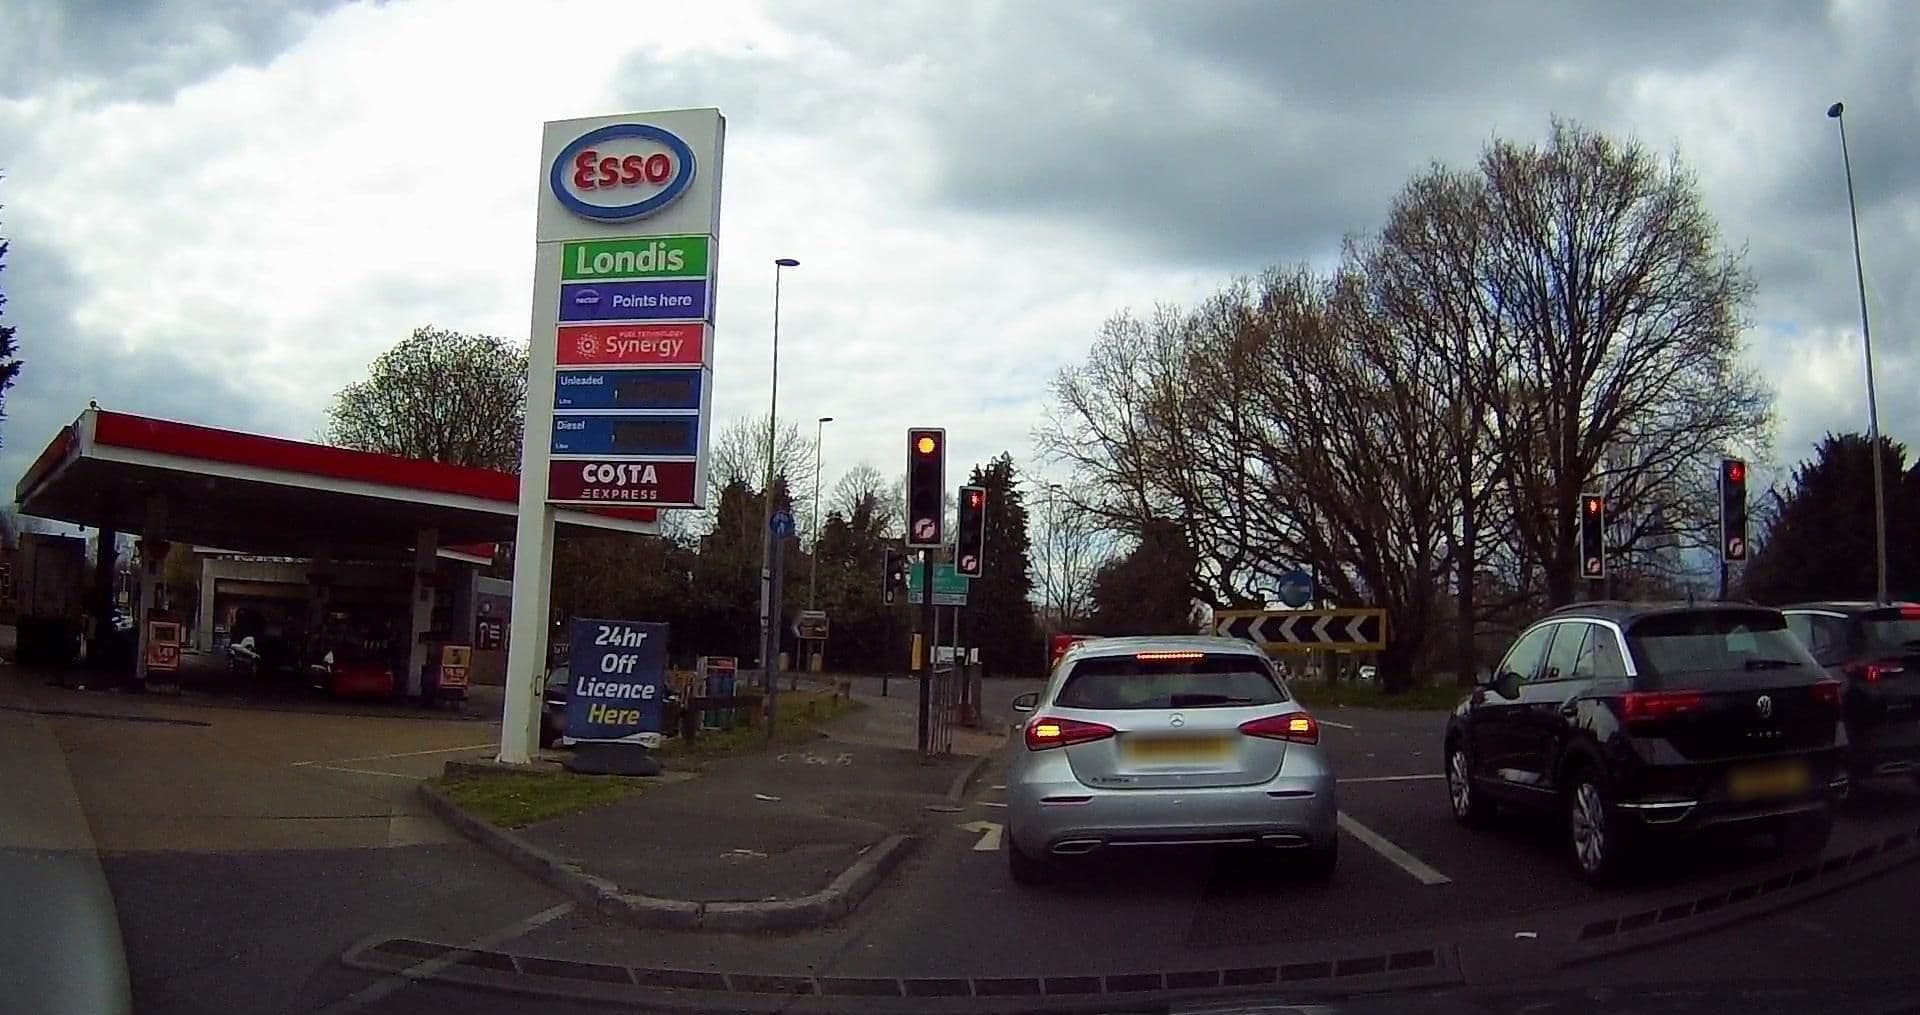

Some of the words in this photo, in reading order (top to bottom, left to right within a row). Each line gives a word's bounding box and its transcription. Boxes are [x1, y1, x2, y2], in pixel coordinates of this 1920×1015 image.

[574, 150, 671, 190] Esso
[576, 242, 684, 274] Londis
[613, 294, 657, 307] Points
[659, 293, 692, 306] here
[606, 336, 684, 358] Synergy
[560, 375, 604, 386] Unleaded
[557, 420, 585, 430] Diesel
[582, 463, 658, 486] COSTA
[592, 488, 657, 500] EXPRESS
[595, 625, 648, 648] 24hr
[601, 653, 639, 674] Off
[576, 676, 655, 699] Licence
[587, 703, 640, 725] Here
